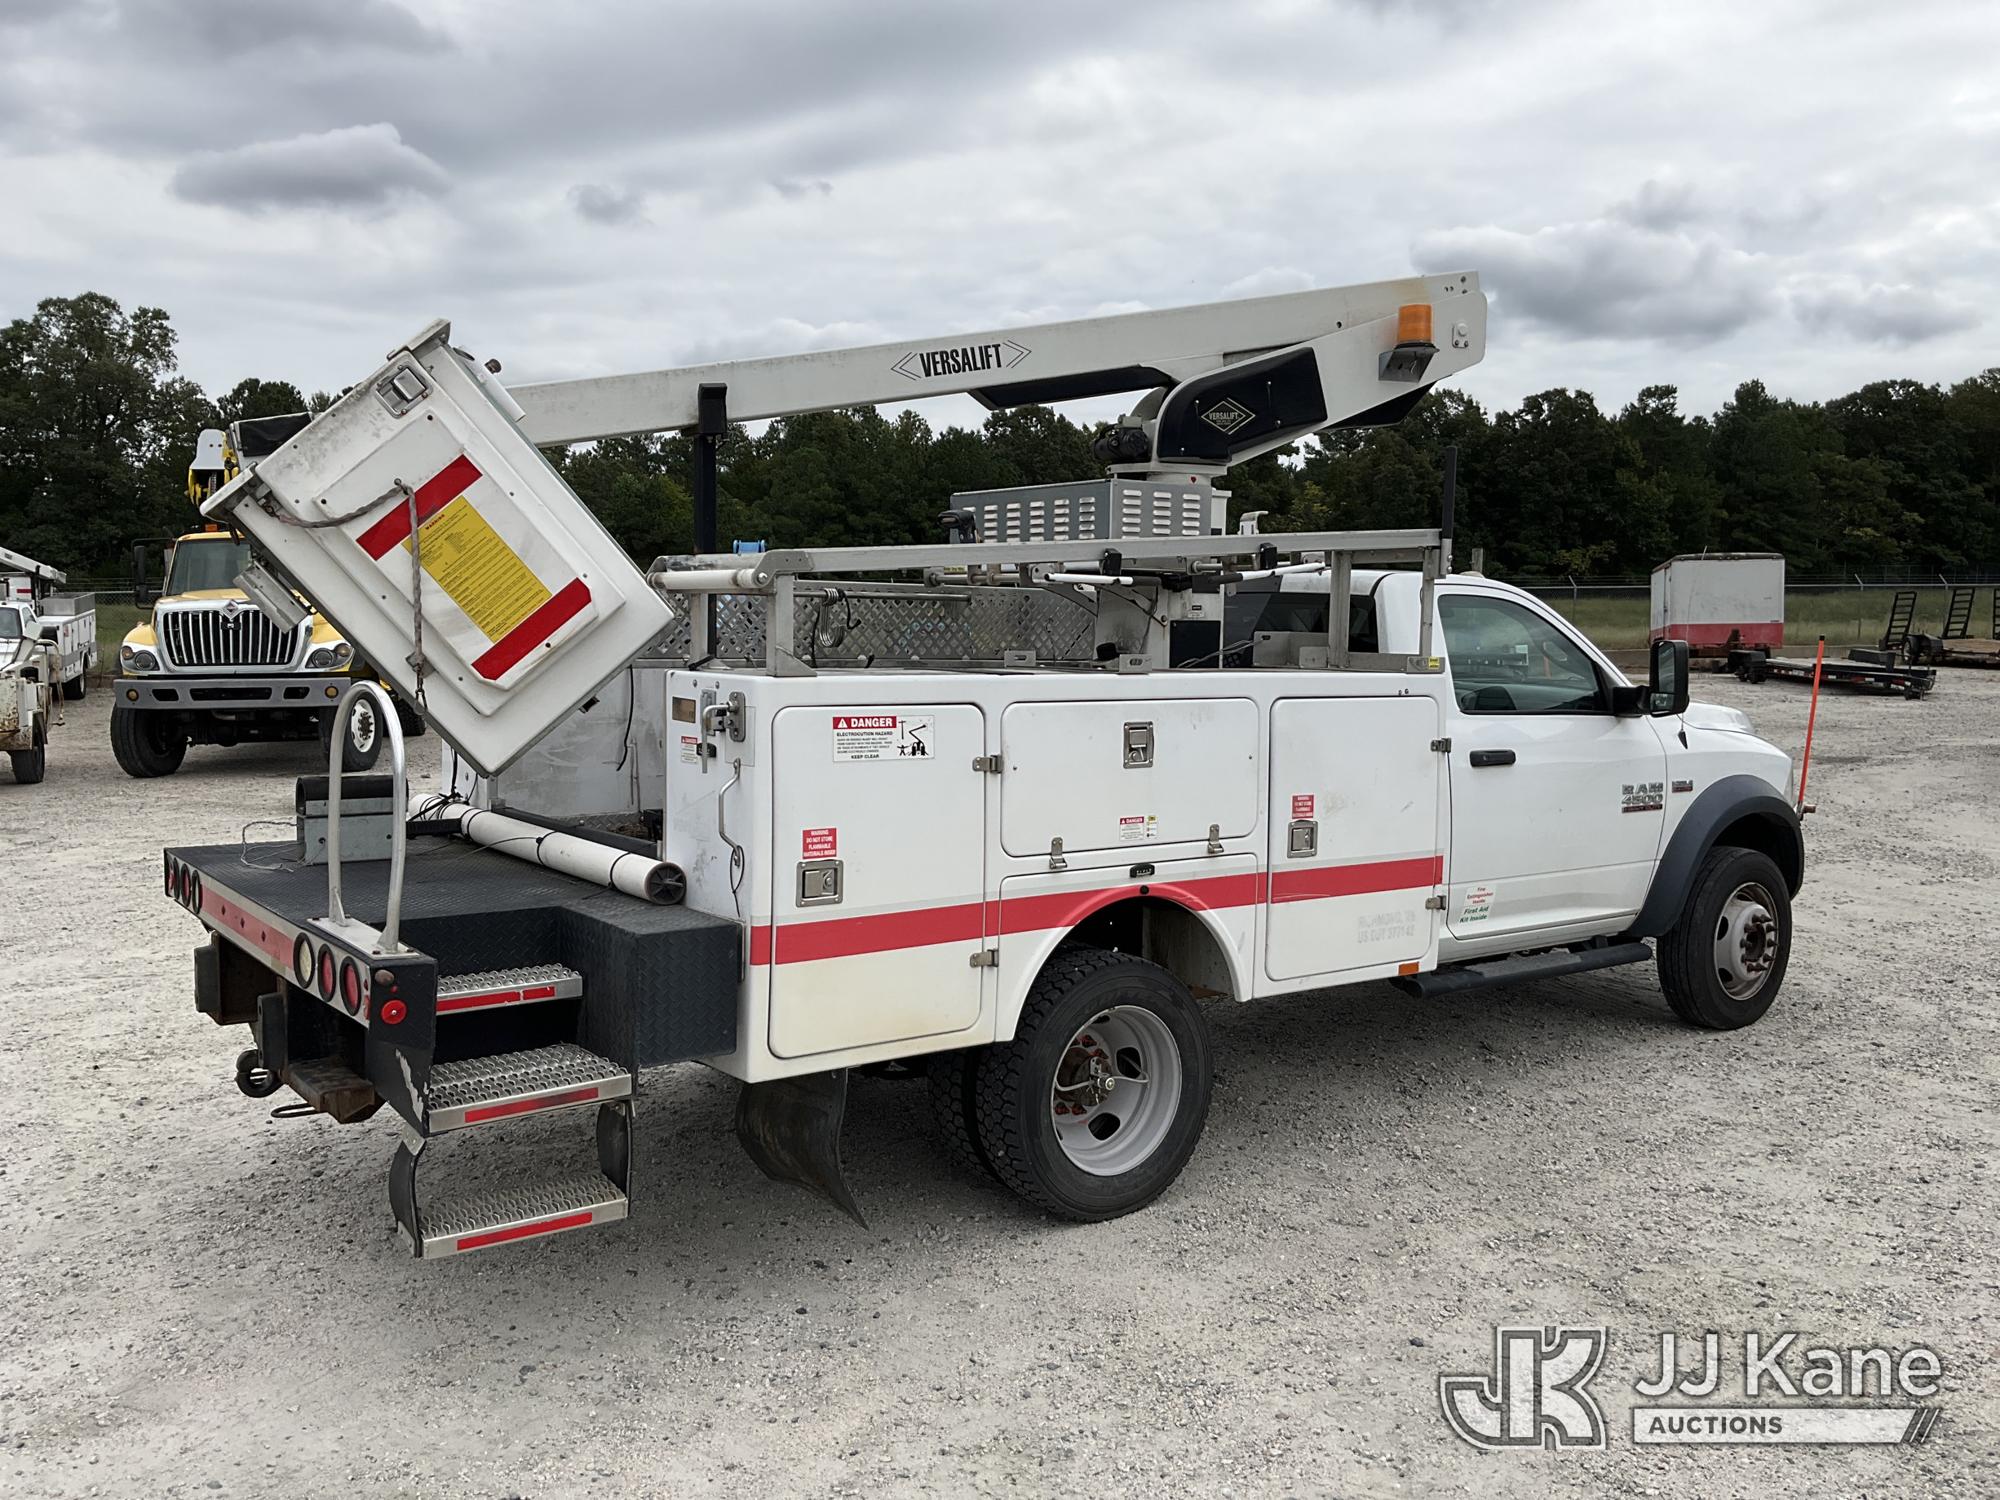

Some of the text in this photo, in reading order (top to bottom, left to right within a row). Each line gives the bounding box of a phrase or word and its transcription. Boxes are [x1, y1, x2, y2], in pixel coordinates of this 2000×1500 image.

[919, 344, 1002, 378] VERSALIFT
[1209, 411, 1239, 420] VERSALIFT
[850, 717, 893, 728] DANGER
[1622, 782, 1664, 795] RAM
[1621, 793, 1664, 804] 4500
[1463, 907, 1478, 915] First
[1469, 914, 1488, 922] Inside
